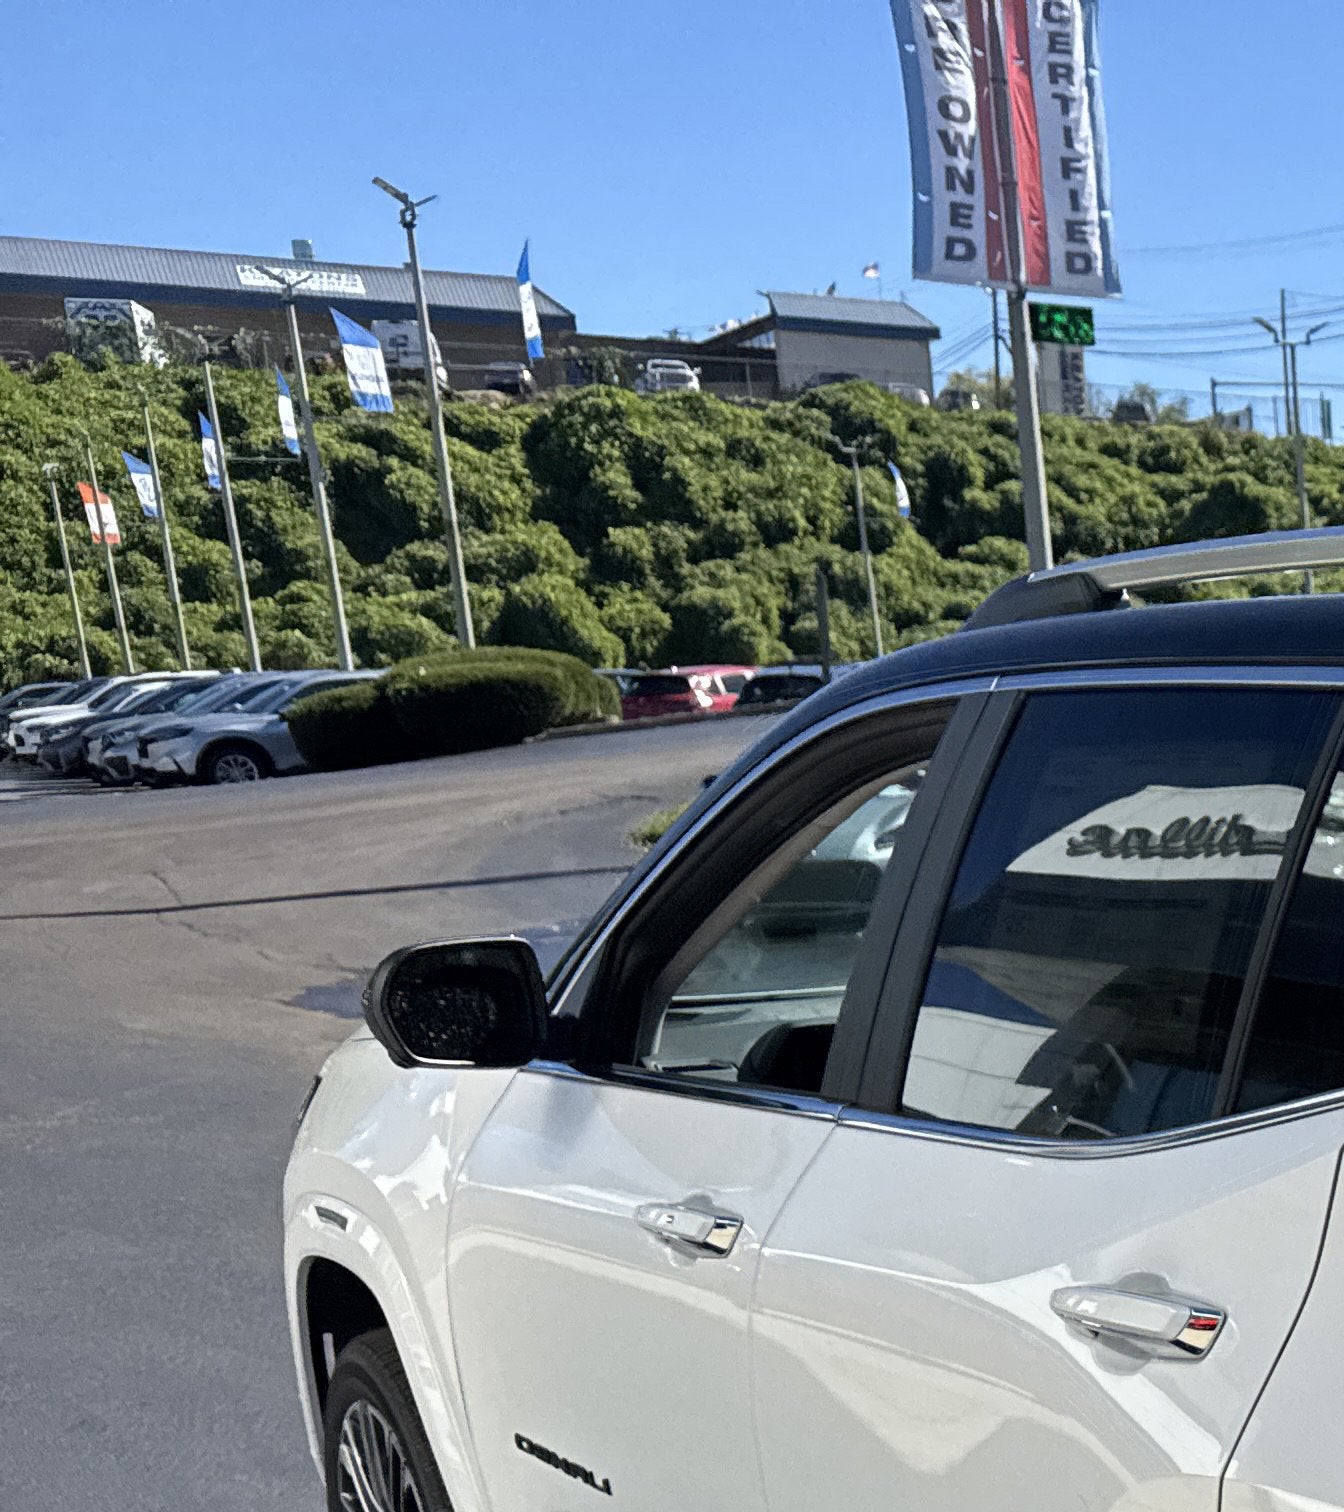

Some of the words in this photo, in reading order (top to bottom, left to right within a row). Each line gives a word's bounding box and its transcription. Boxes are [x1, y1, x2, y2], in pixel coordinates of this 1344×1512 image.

[936, 94, 977, 263] OWNED
[1041, 0, 1094, 276] CERTIFIED
[513, 1431, 614, 1497] DENALI
